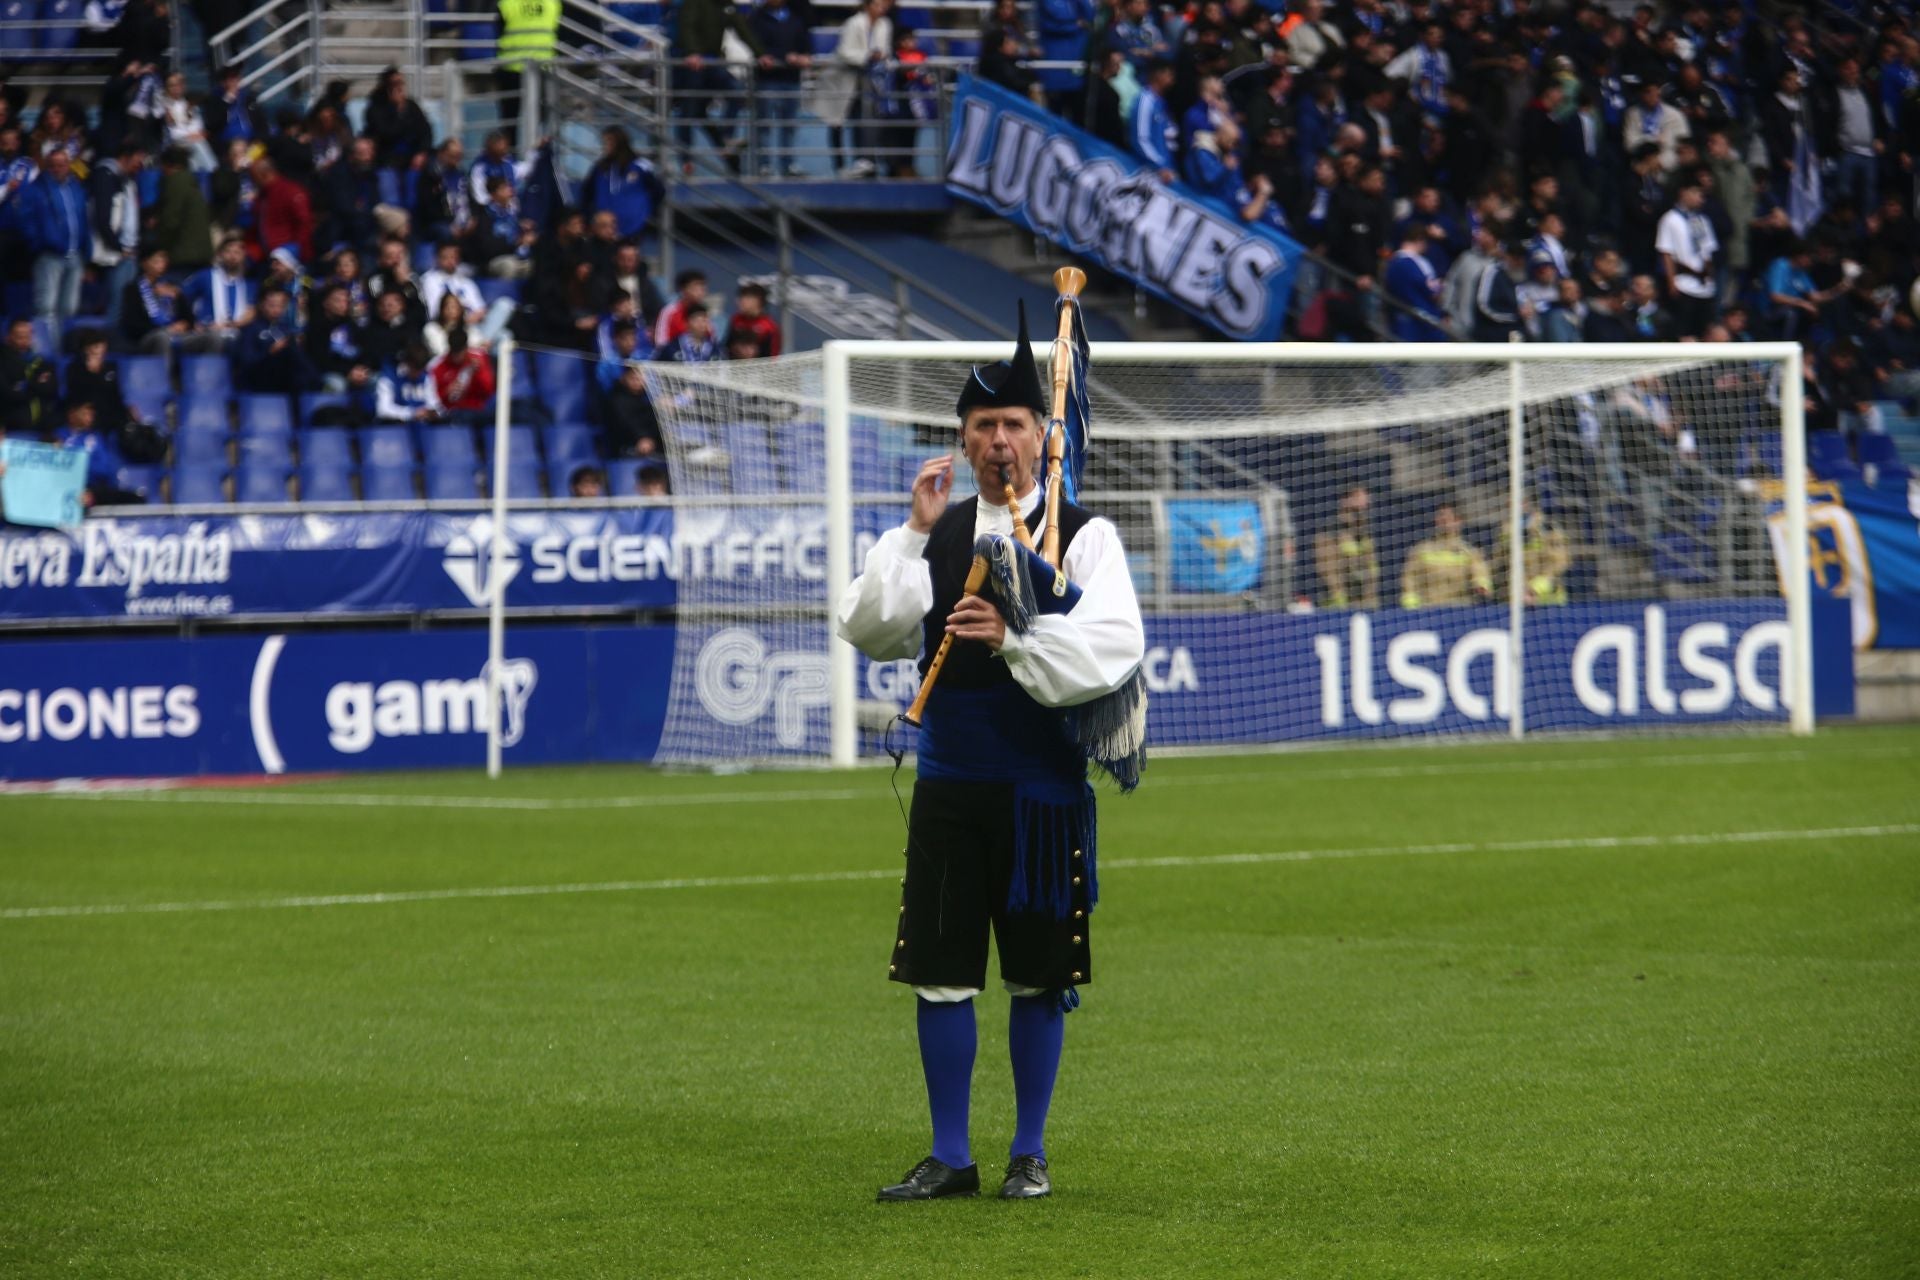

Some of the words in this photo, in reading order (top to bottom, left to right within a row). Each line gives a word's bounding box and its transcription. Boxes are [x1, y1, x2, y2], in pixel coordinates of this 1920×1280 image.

[74, 519, 232, 598] España
[1571, 603, 1798, 717] alsa
[0, 684, 201, 743] CIONES
